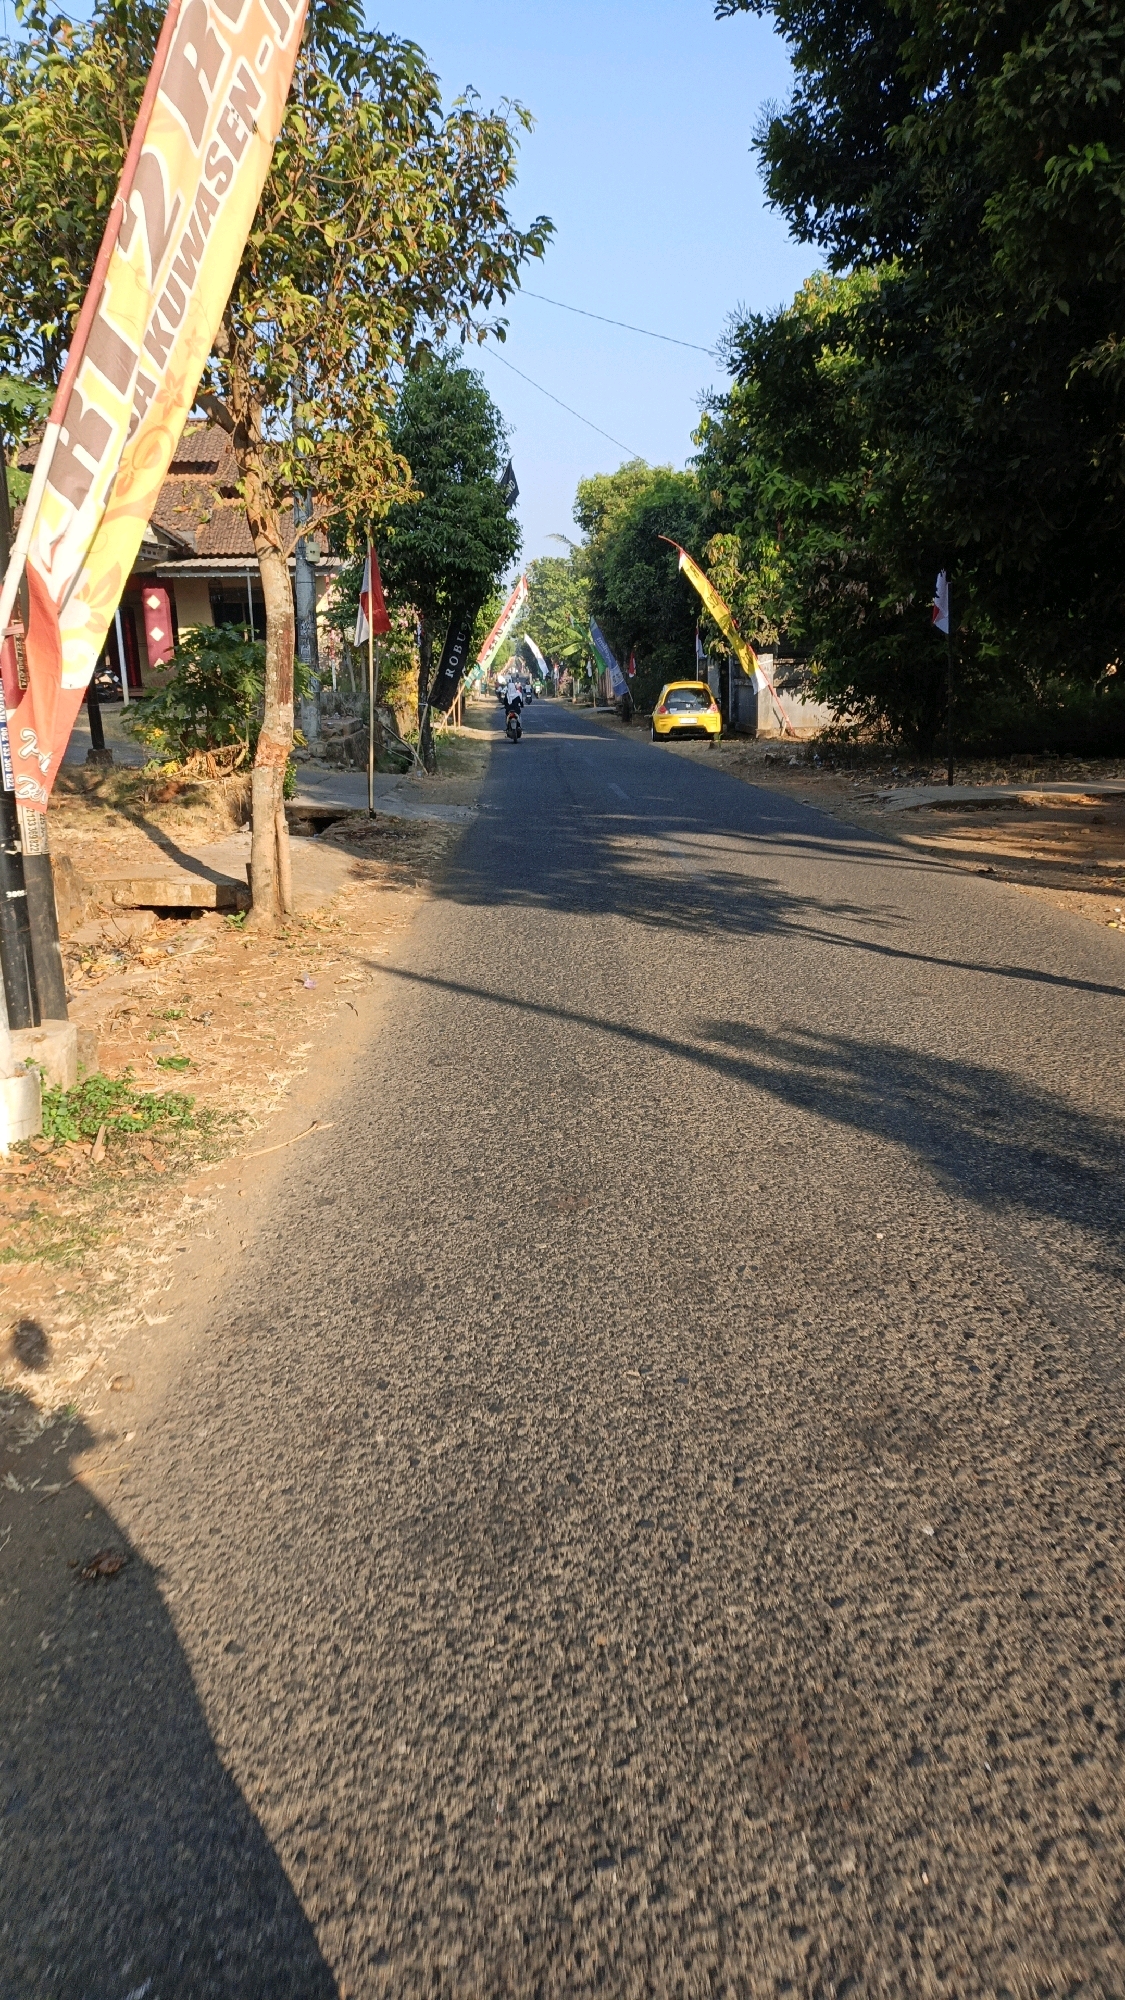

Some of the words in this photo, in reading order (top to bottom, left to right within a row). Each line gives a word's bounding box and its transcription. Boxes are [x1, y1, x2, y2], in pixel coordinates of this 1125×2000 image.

[47, 289, 140, 512] RT
[118, 151, 181, 281] 2
[145, 64, 262, 370] KUWASEN
